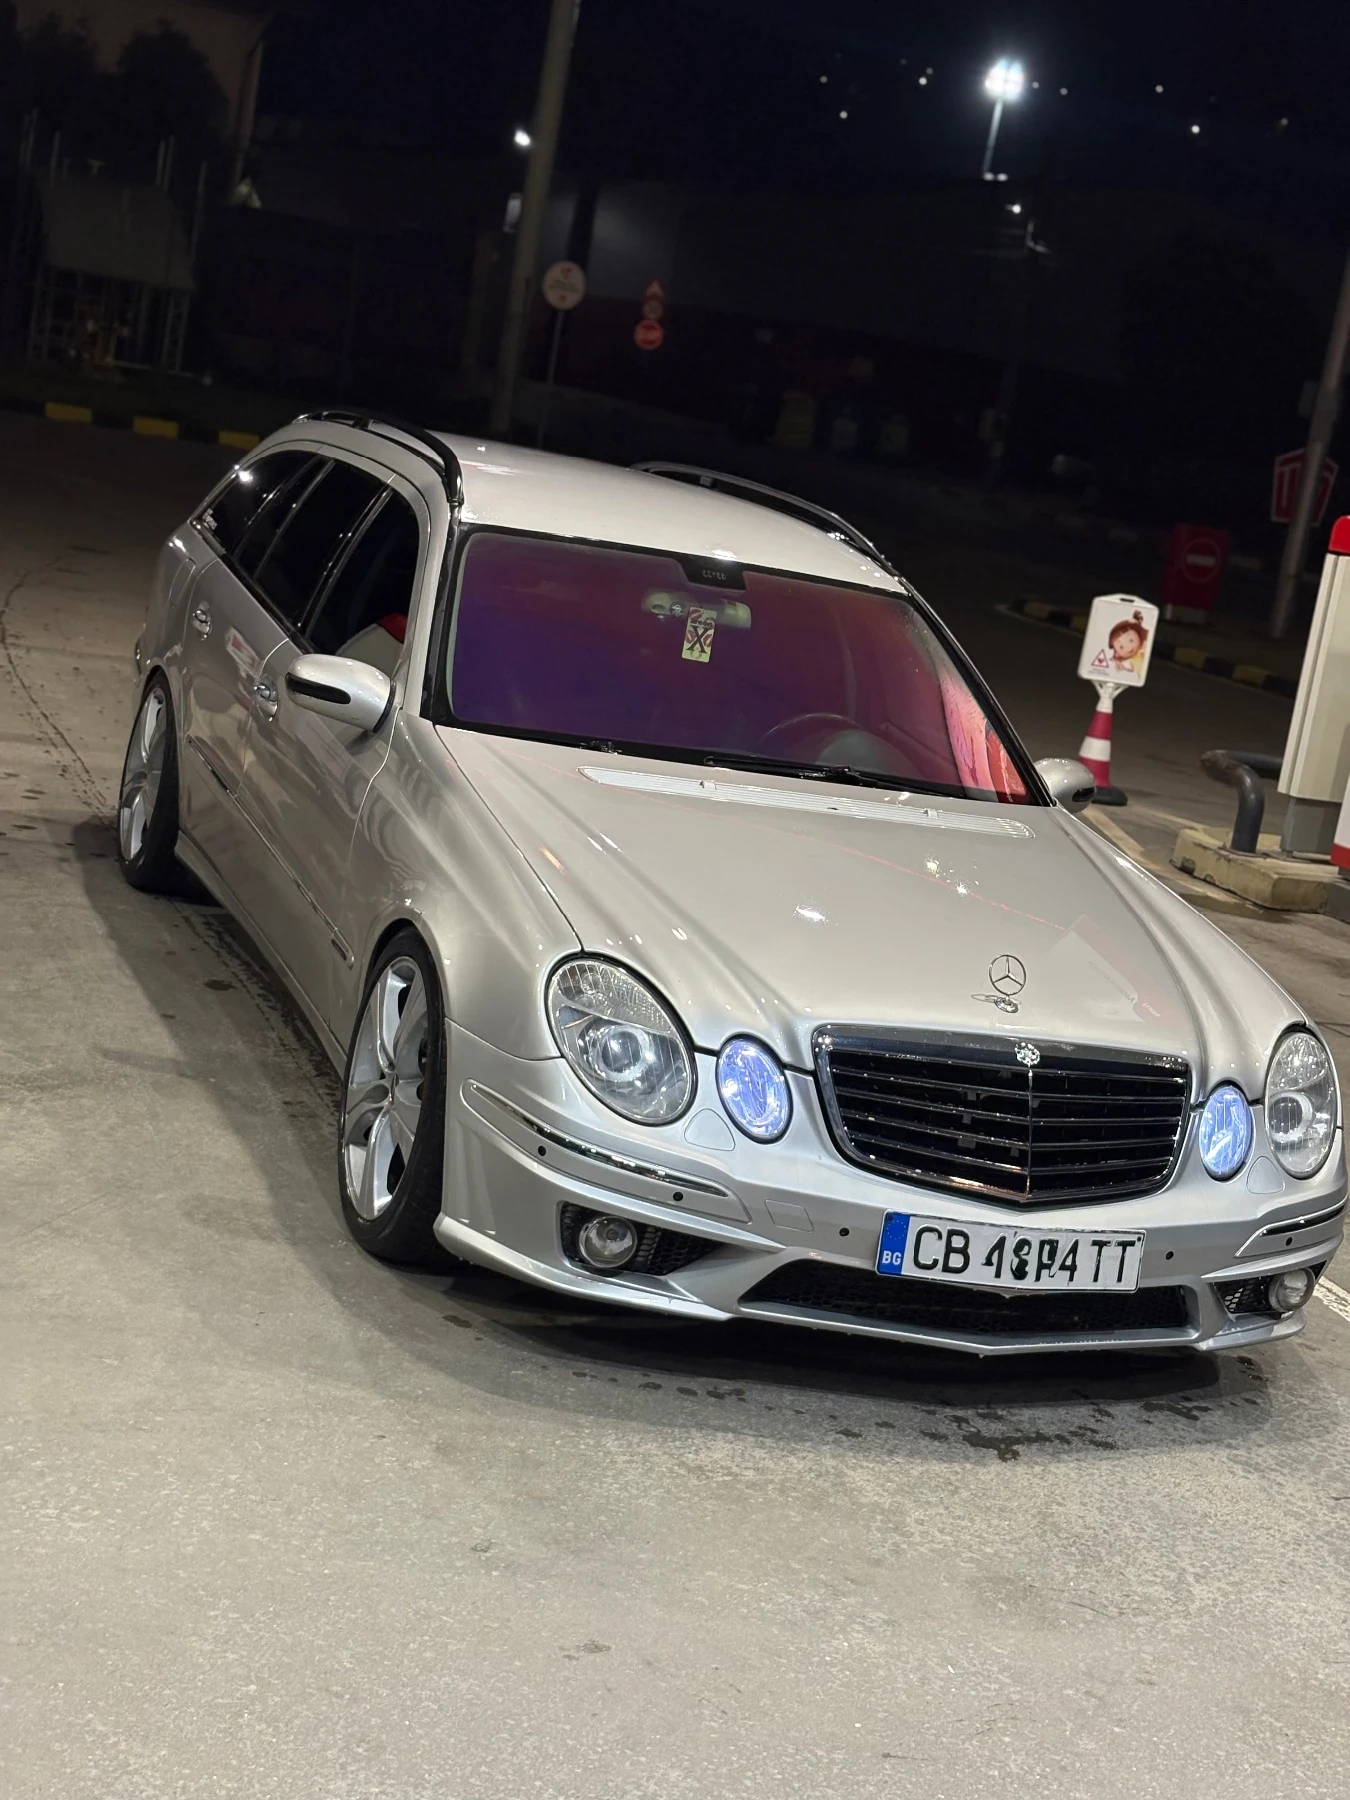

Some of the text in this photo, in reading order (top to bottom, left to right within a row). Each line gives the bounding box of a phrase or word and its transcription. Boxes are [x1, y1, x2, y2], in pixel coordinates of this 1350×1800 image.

[881, 1249, 901, 1266] BG
[913, 1223, 970, 1275] CB
[1091, 1239, 1137, 1283] TT
